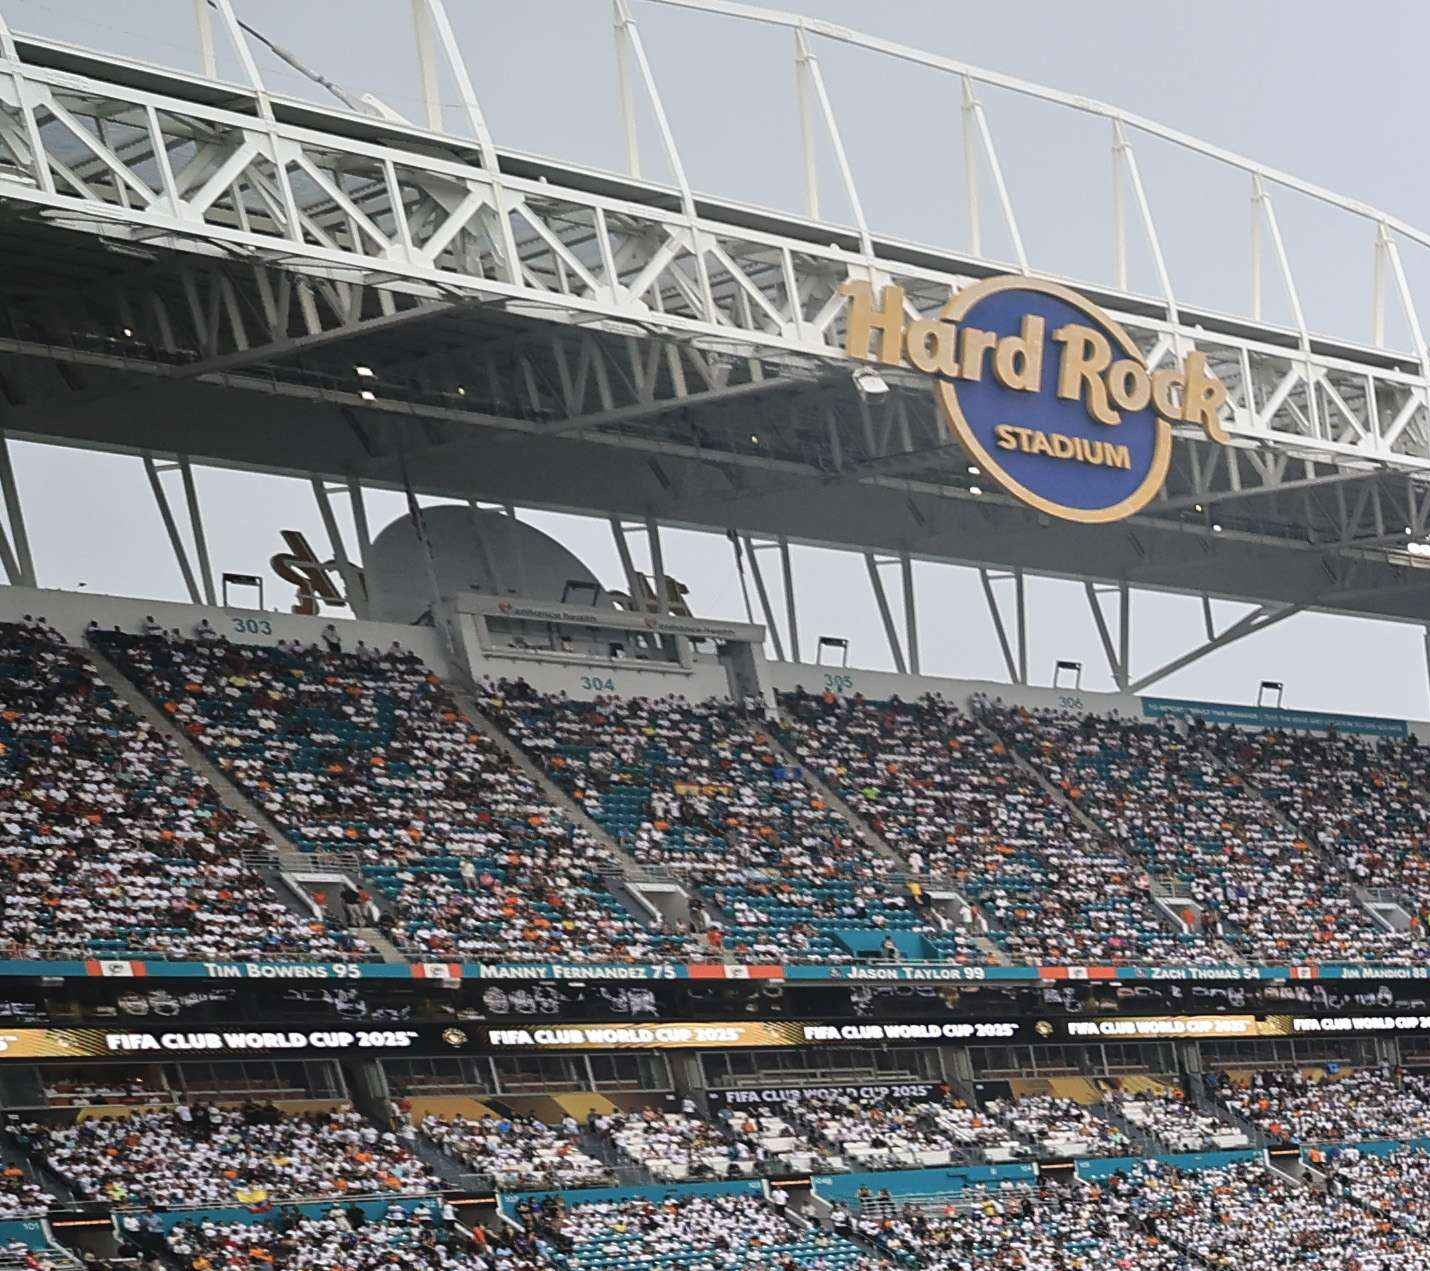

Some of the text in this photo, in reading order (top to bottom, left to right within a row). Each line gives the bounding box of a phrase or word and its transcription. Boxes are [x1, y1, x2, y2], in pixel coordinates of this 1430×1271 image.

[841, 285, 1230, 445] Hard Rock
[994, 424, 1132, 470] STADIUM
[581, 677, 616, 691] 304
[332, 963, 362, 978] 95
[651, 966, 676, 978] 75
[963, 967, 985, 979] 99
[1244, 967, 1260, 979] 54
[804, 1026, 840, 1040] FIFA
[845, 1026, 881, 1039] CLUB
[884, 1025, 940, 1038] WORLD
[942, 1024, 973, 1038] CUP
[106, 1035, 160, 1051] FIFA
[161, 1033, 222, 1049] CLUB
[225, 1032, 308, 1048] WORLD
[308, 1032, 355, 1047] CUP
